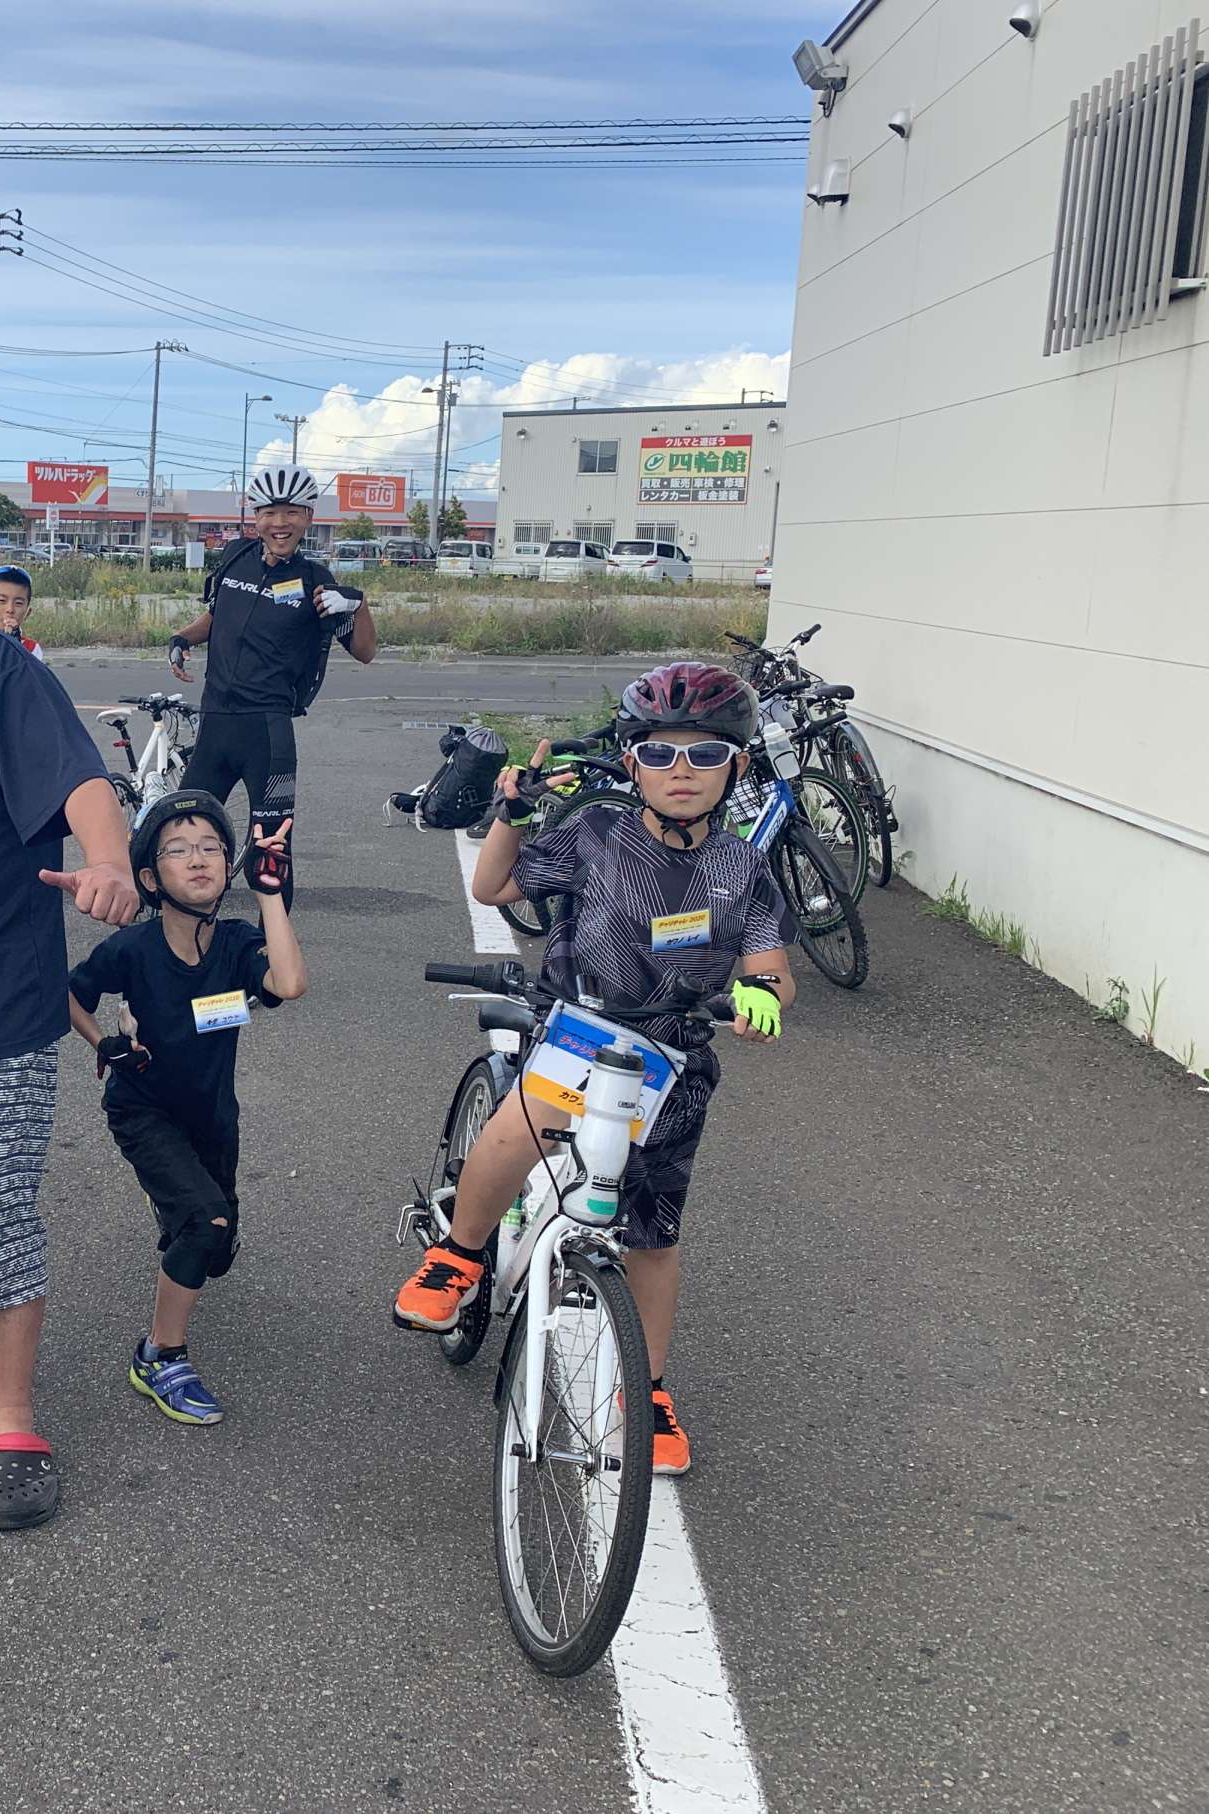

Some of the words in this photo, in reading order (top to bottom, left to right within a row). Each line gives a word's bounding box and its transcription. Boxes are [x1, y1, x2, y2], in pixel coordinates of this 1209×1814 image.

[665, 437, 727, 448] クルマと遊ぼう
[668, 450, 748, 474] 四輪館
[34, 466, 97, 483] ツルハドラッグ
[368, 488, 391, 503] BIG
[640, 490, 690, 501] レンタカー
[221, 577, 260, 594] PEARL
